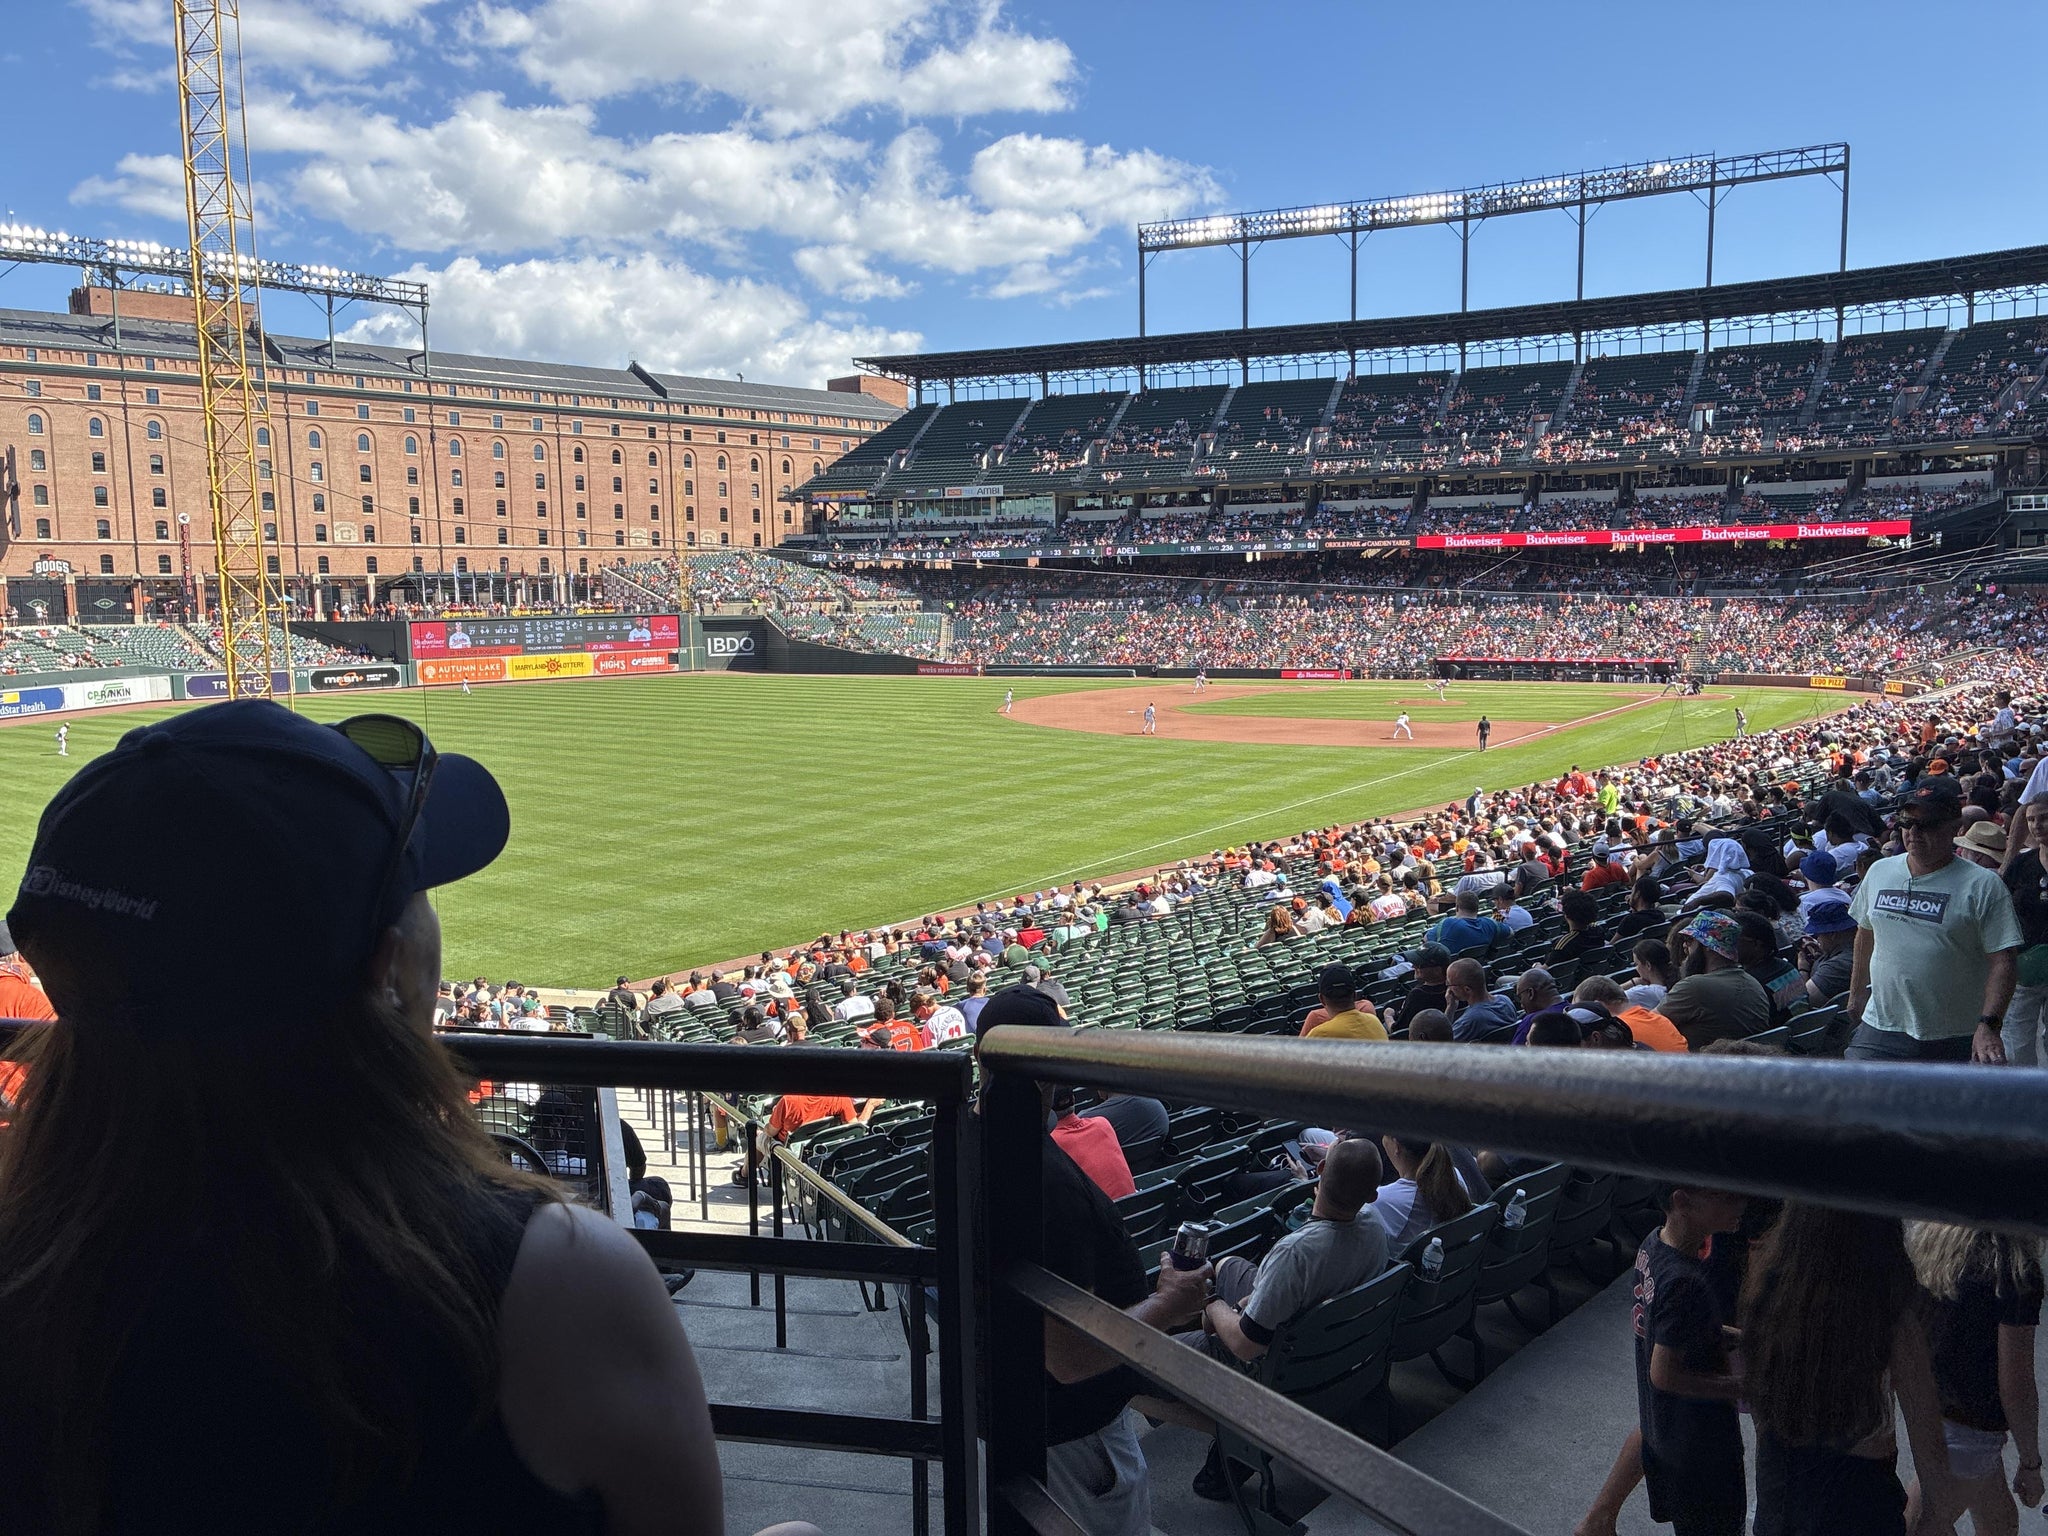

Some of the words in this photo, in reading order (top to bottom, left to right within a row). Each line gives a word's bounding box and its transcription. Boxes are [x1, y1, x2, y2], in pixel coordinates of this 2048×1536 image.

[714, 637, 754, 652] BDO
[439, 664, 476, 673] AUTUMN
[212, 680, 252, 689] TRST
[21, 702, 46, 712] Health
[1876, 895, 1941, 913] INCLUSION
